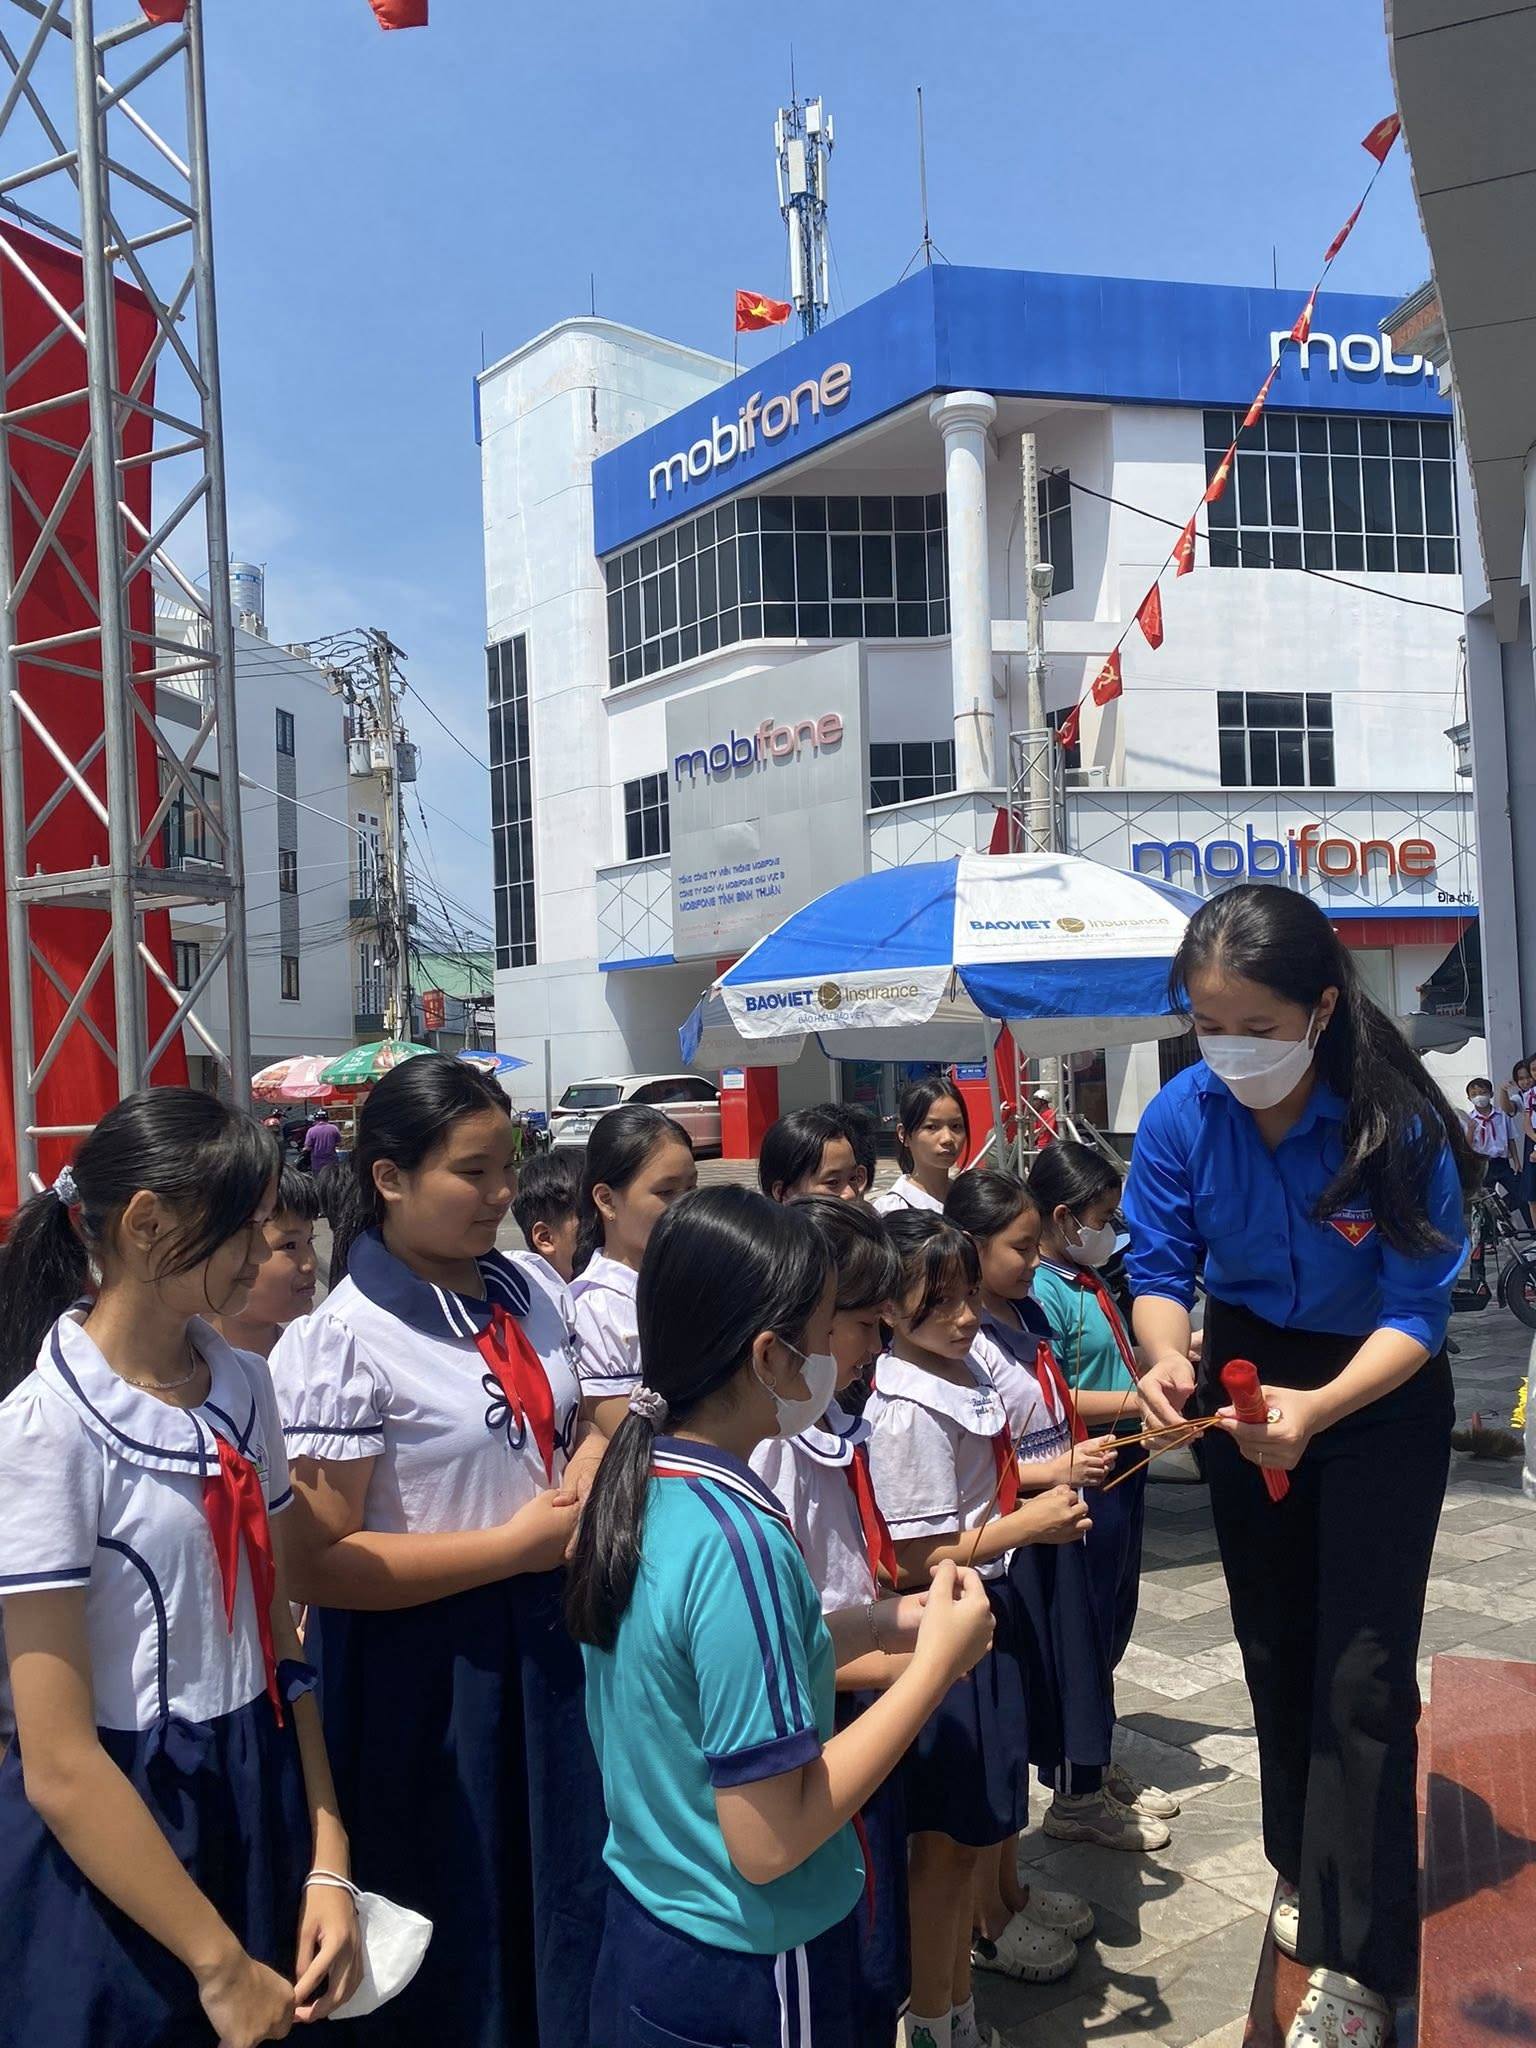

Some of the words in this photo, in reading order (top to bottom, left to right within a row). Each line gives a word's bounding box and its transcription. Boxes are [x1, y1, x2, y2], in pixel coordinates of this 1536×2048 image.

[649, 362, 852, 501] mobifone
[675, 711, 844, 783] mobifone
[1132, 823, 1437, 878] mobifone
[709, 870, 718, 879] TY
[752, 857, 780, 871] MOBIFONE
[679, 896, 716, 912] MOBIFONE
[718, 891, 735, 906] TỈNH
[736, 889, 754, 903] BÌNH
[755, 884, 782, 900] THUẬN
[694, 887, 703, 895] TY
[725, 876, 754, 889] MOBIFONE
[1438, 892, 1455, 904] Địa
[969, 920, 1051, 931] BAOVIET
[1087, 917, 1170, 929] Insurance
[745, 990, 813, 1012] BAOVIET
[844, 984, 918, 1002] Insurance
